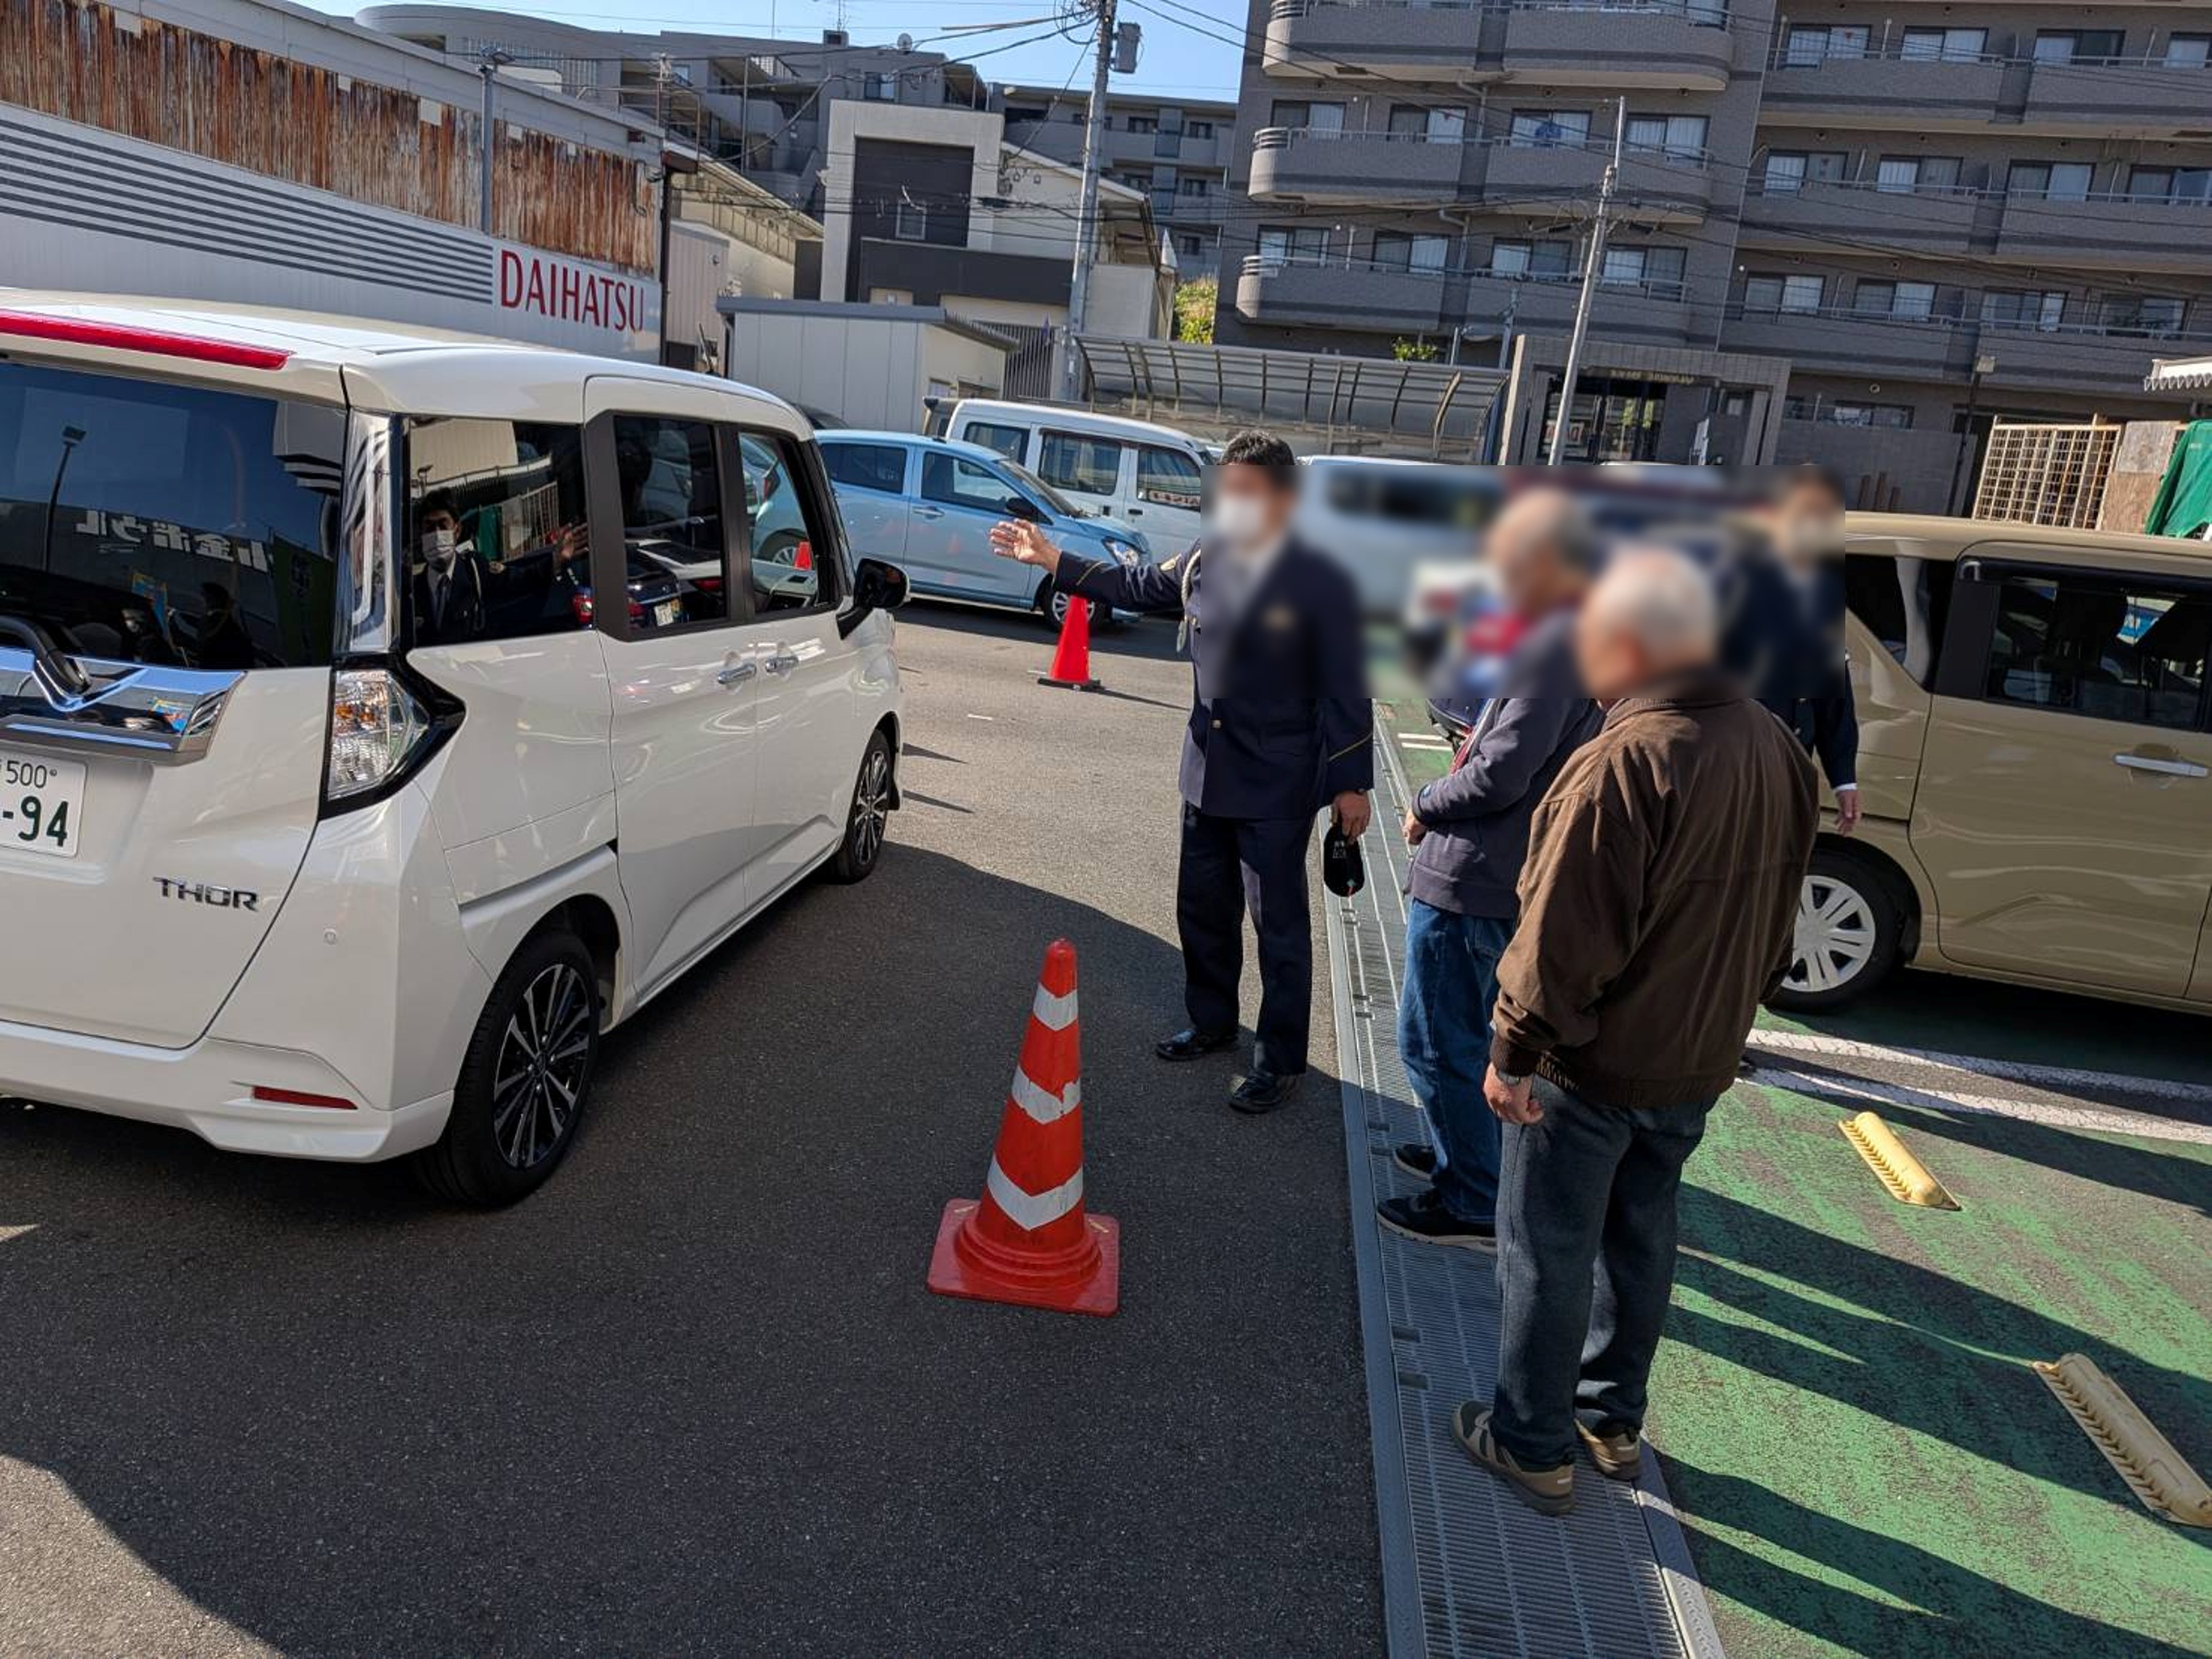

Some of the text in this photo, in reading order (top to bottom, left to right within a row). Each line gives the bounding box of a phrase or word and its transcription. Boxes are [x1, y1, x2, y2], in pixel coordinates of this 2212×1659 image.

[501, 249, 644, 333] DAIHATSU
[6, 759, 47, 788] 500
[153, 877, 259, 912] THOR
